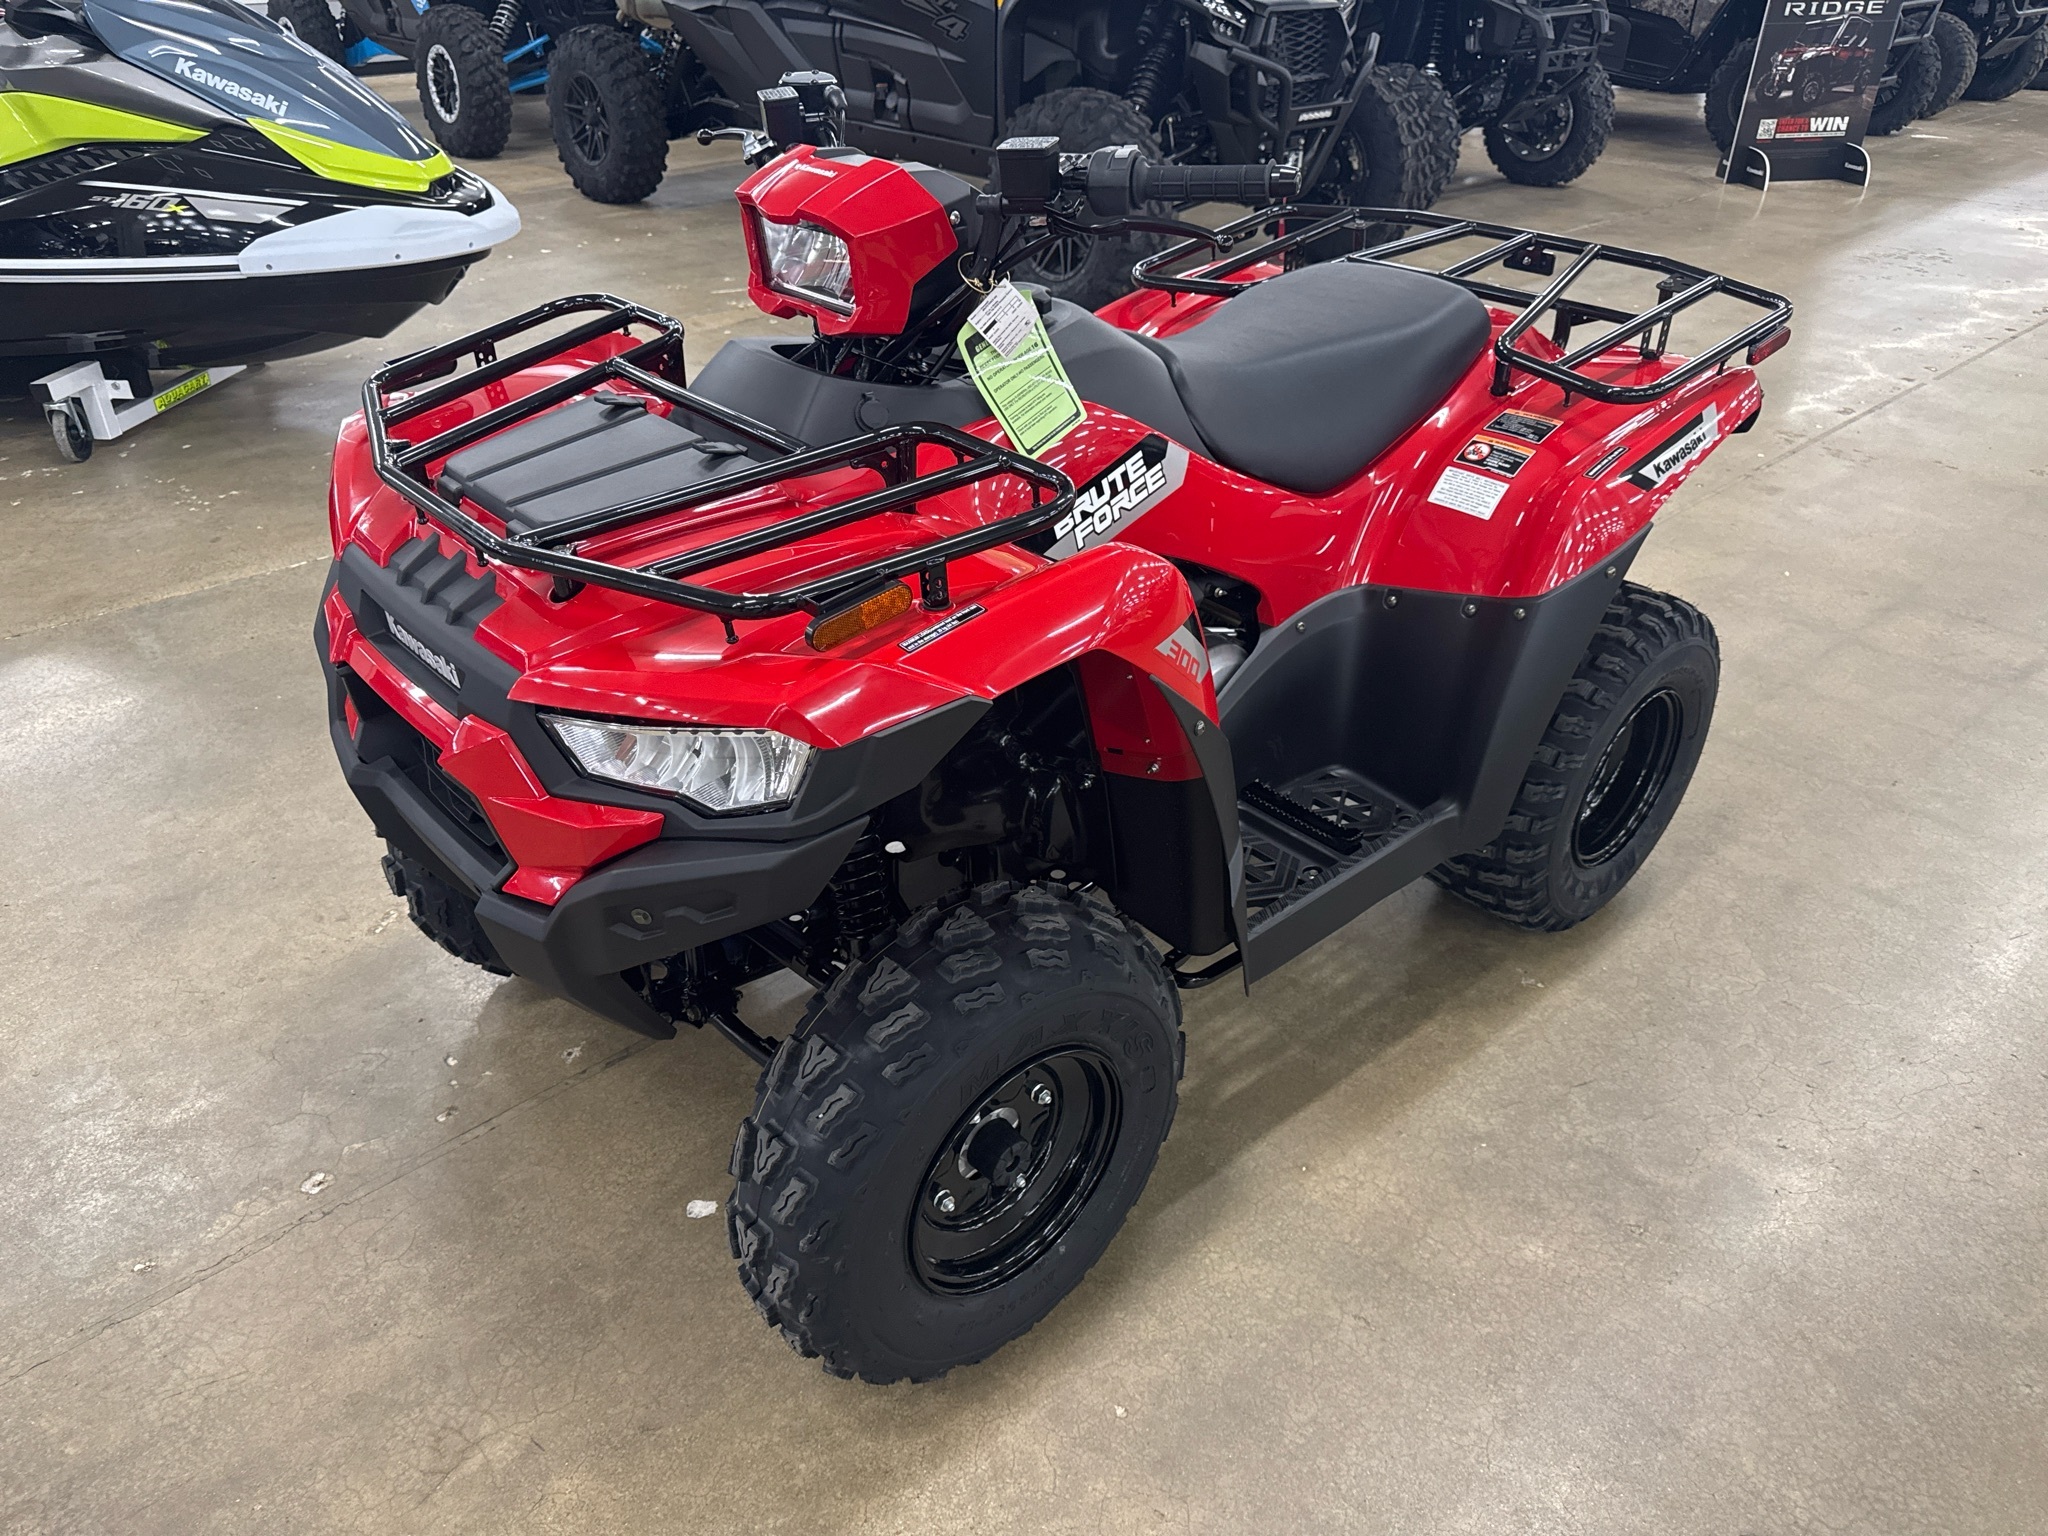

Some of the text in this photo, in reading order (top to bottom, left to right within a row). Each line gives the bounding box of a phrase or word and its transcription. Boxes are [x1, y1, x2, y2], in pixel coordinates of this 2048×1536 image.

[1784, 1, 1886, 17] RIDGE
[174, 57, 289, 117] Kawasaki
[1810, 116, 1850, 131] WIN
[1031, 341, 1039, 350] 16
[1653, 427, 1707, 479] Kawasaki
[1053, 450, 1148, 540] BRUTE
[1074, 463, 1167, 550] FORCE
[384, 610, 461, 689] Kawasaki
[1167, 639, 1200, 682] 300
